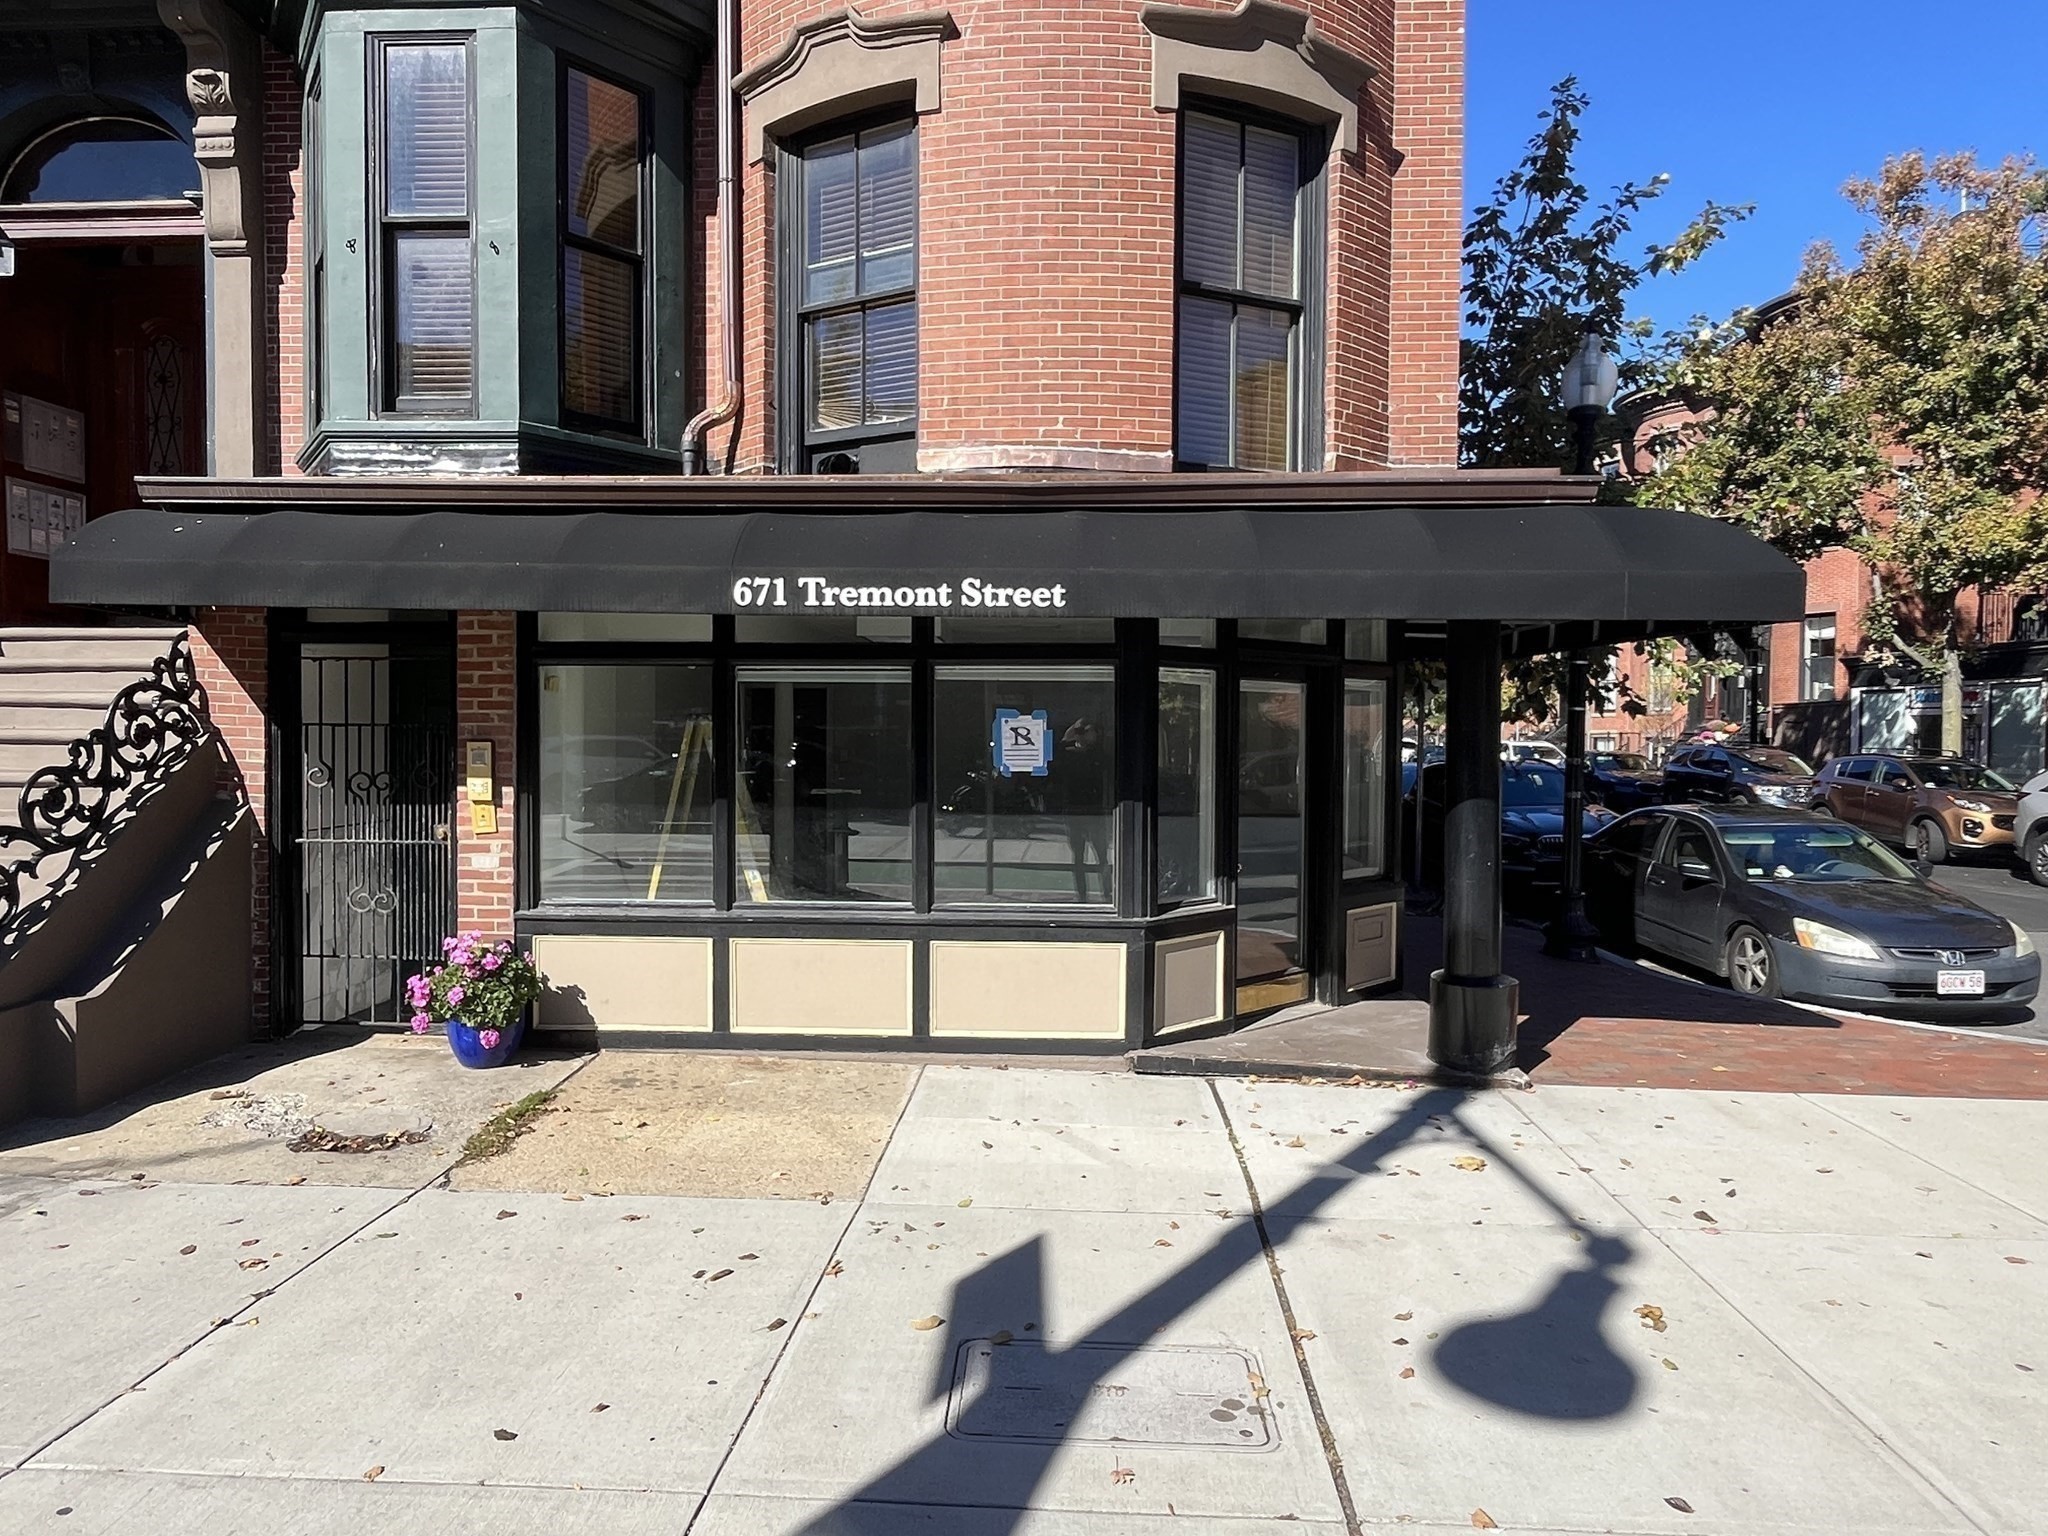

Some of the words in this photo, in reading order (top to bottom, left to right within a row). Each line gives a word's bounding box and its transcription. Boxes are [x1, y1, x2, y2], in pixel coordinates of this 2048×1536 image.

[732, 576, 788, 607] 671
[797, 576, 953, 607] Tremont
[960, 577, 1067, 607] Street
